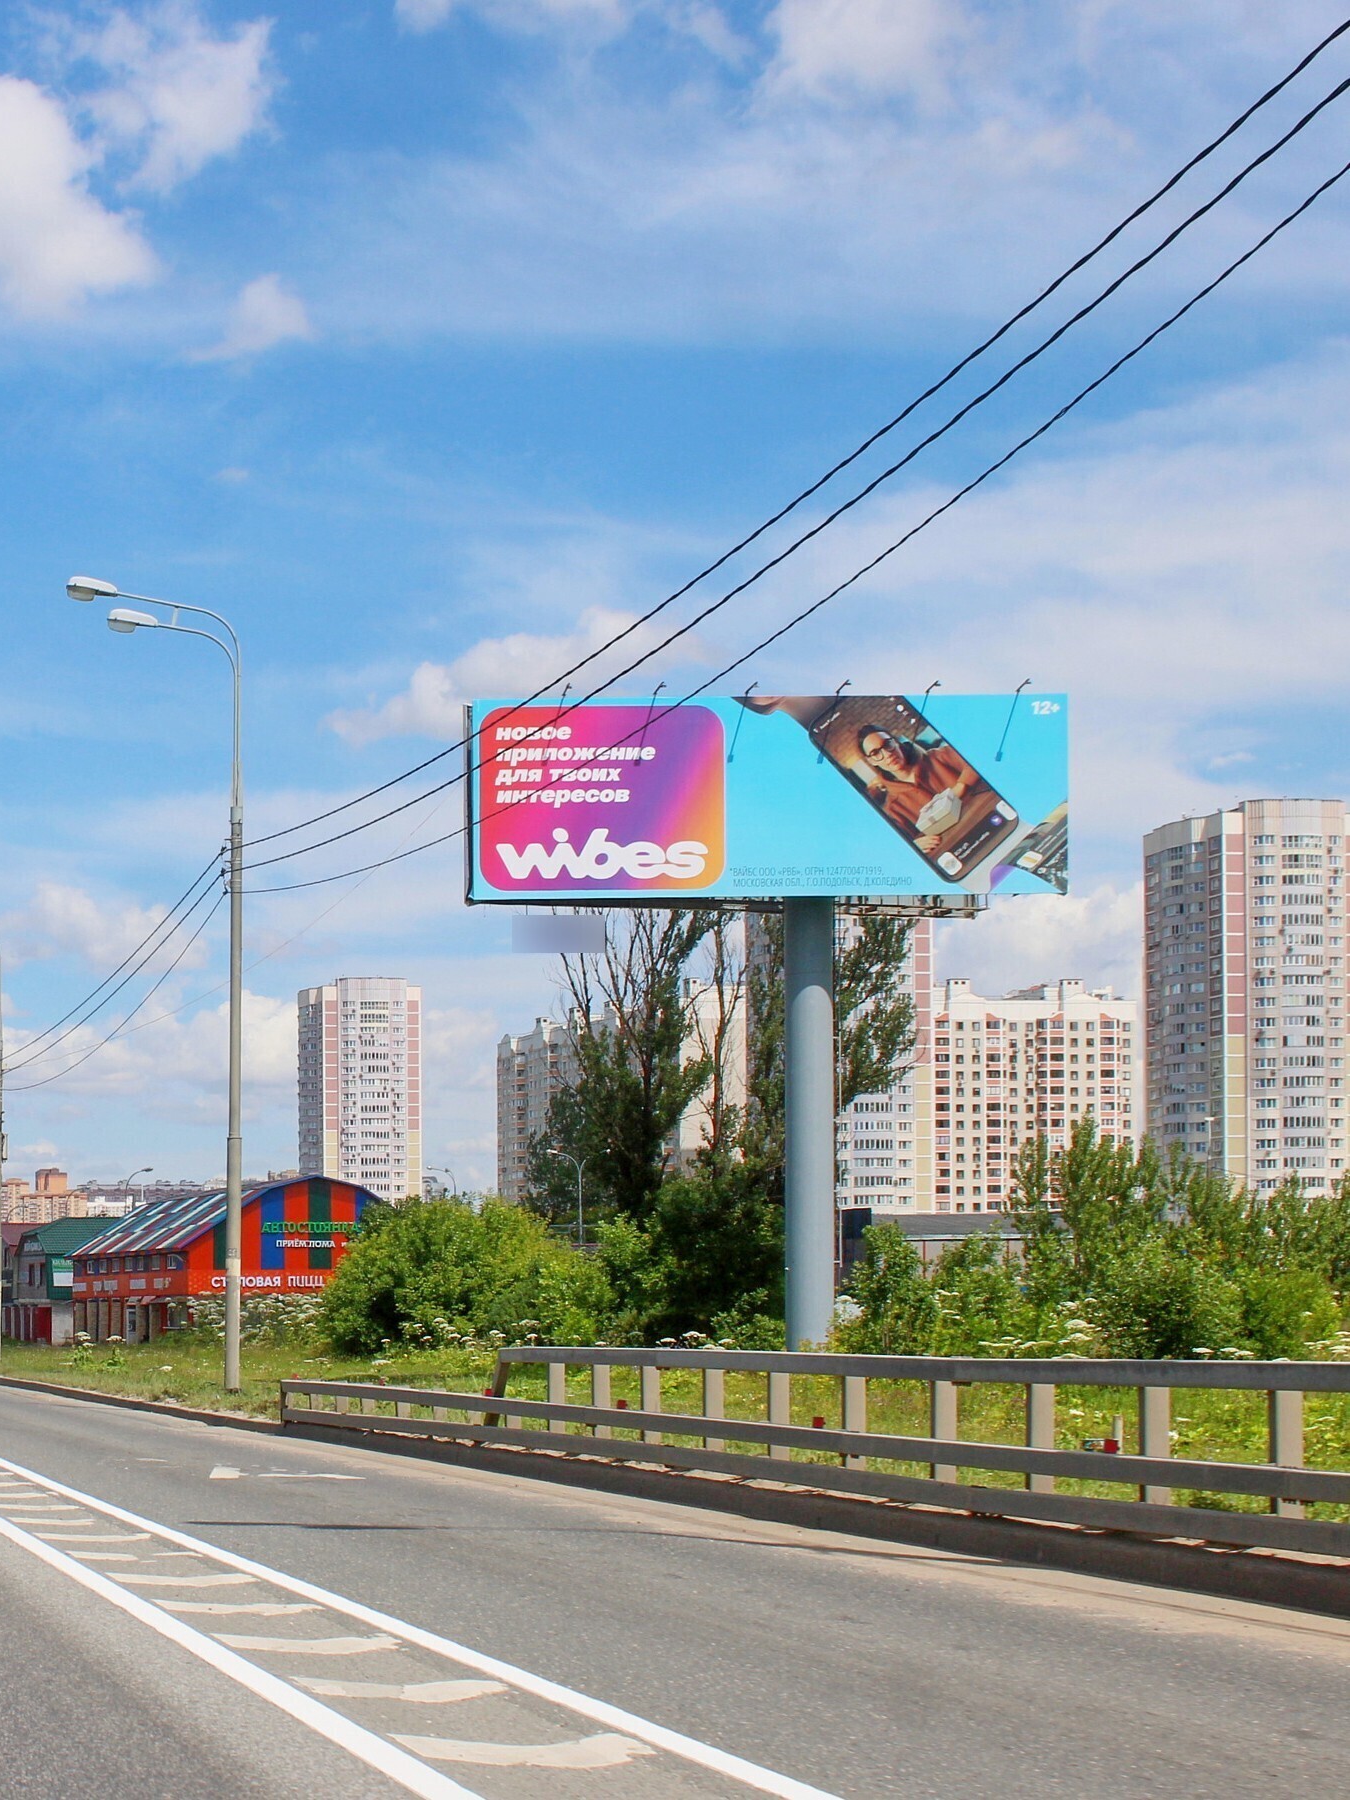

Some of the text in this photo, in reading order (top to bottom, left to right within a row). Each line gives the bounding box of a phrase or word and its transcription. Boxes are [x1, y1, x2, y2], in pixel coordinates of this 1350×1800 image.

[1031, 700, 1060, 715] 12+
[496, 726, 572, 741] новое
[496, 746, 656, 766] приложение
[495, 768, 543, 785] для
[549, 767, 622, 782] твоих
[496, 789, 630, 808] интересов
[496, 828, 709, 880] wibes
[261, 1221, 360, 1233] АВТОСТОЯНКА
[276, 1238, 307, 1248] ПРИЁМ
[308, 1240, 336, 1248] ЛОМА
[211, 1276, 325, 1287] СТЛОВАЯ ПИЦЦ
